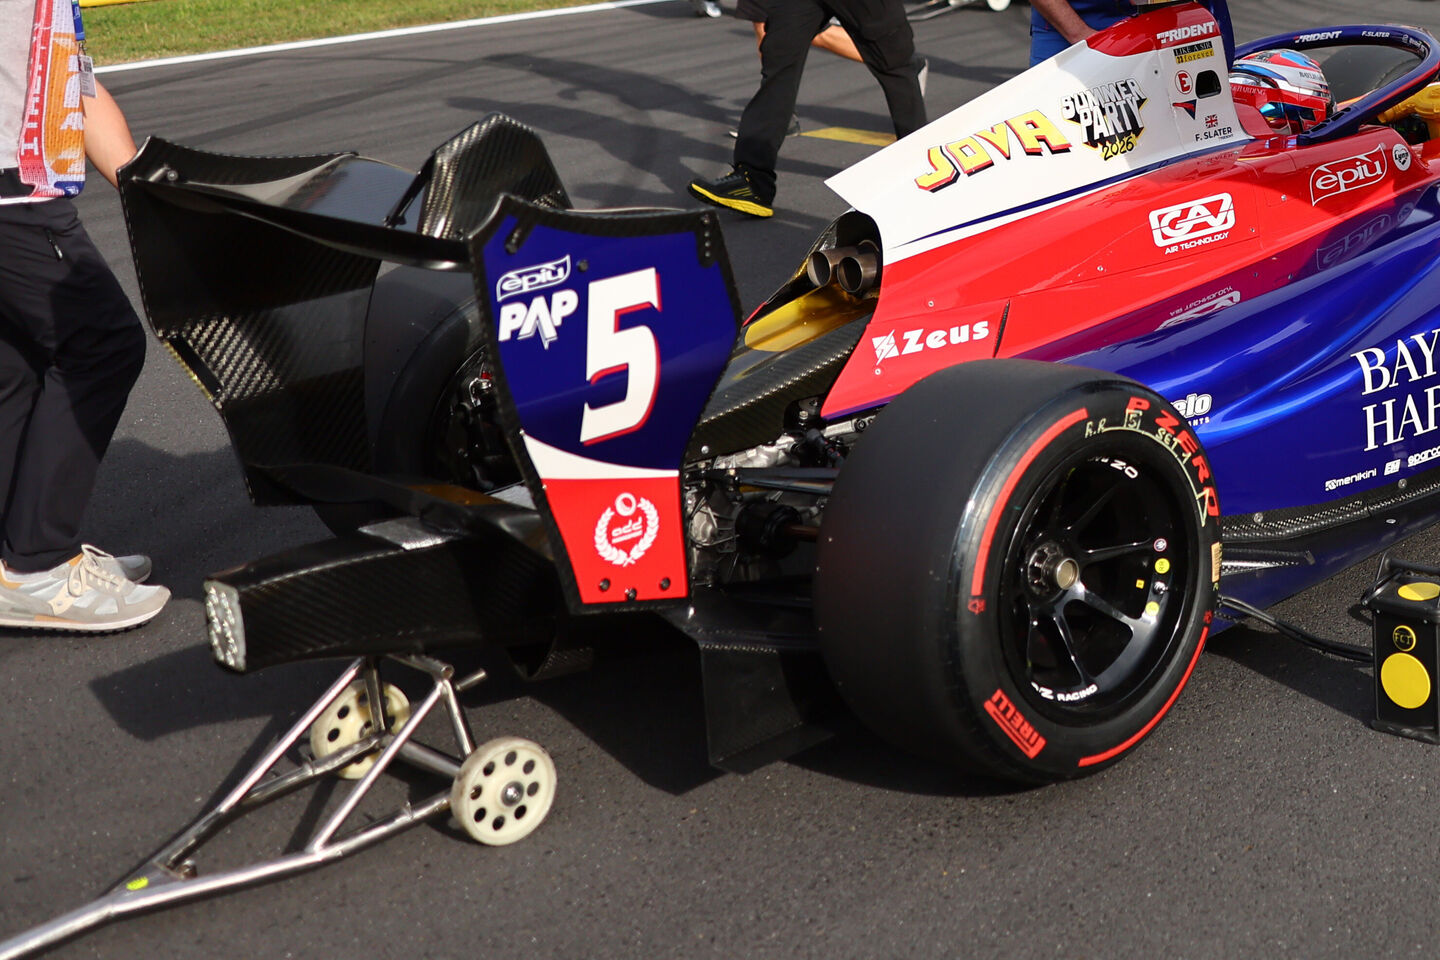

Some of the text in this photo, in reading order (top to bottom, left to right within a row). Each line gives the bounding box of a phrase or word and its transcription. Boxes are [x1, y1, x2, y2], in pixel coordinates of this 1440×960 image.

[1156, 21, 1215, 44] TRIDENT
[1294, 31, 1343, 43] TRIDENT
[1175, 47, 1192, 56] LIKE
[1200, 41, 1212, 50] SIR
[1184, 49, 1214, 61] forever
[1061, 77, 1148, 120] SUMMER
[1080, 97, 1145, 144] PARTY
[1195, 126, 1233, 142] F. SLATER
[914, 108, 1073, 193] JOVA
[1102, 136, 1135, 162] 2026
[1155, 198, 1232, 242] GAV
[1164, 231, 1230, 255] AIR TECHNOLOGY
[498, 289, 579, 349] PAP
[902, 319, 990, 356] Zeus
[580, 267, 662, 446] 5
[1155, 426, 1182, 451] SET
[1126, 396, 1220, 517] P ZERO
[1056, 684, 1098, 702] RACING
[983, 688, 1048, 759] PIRELLI
